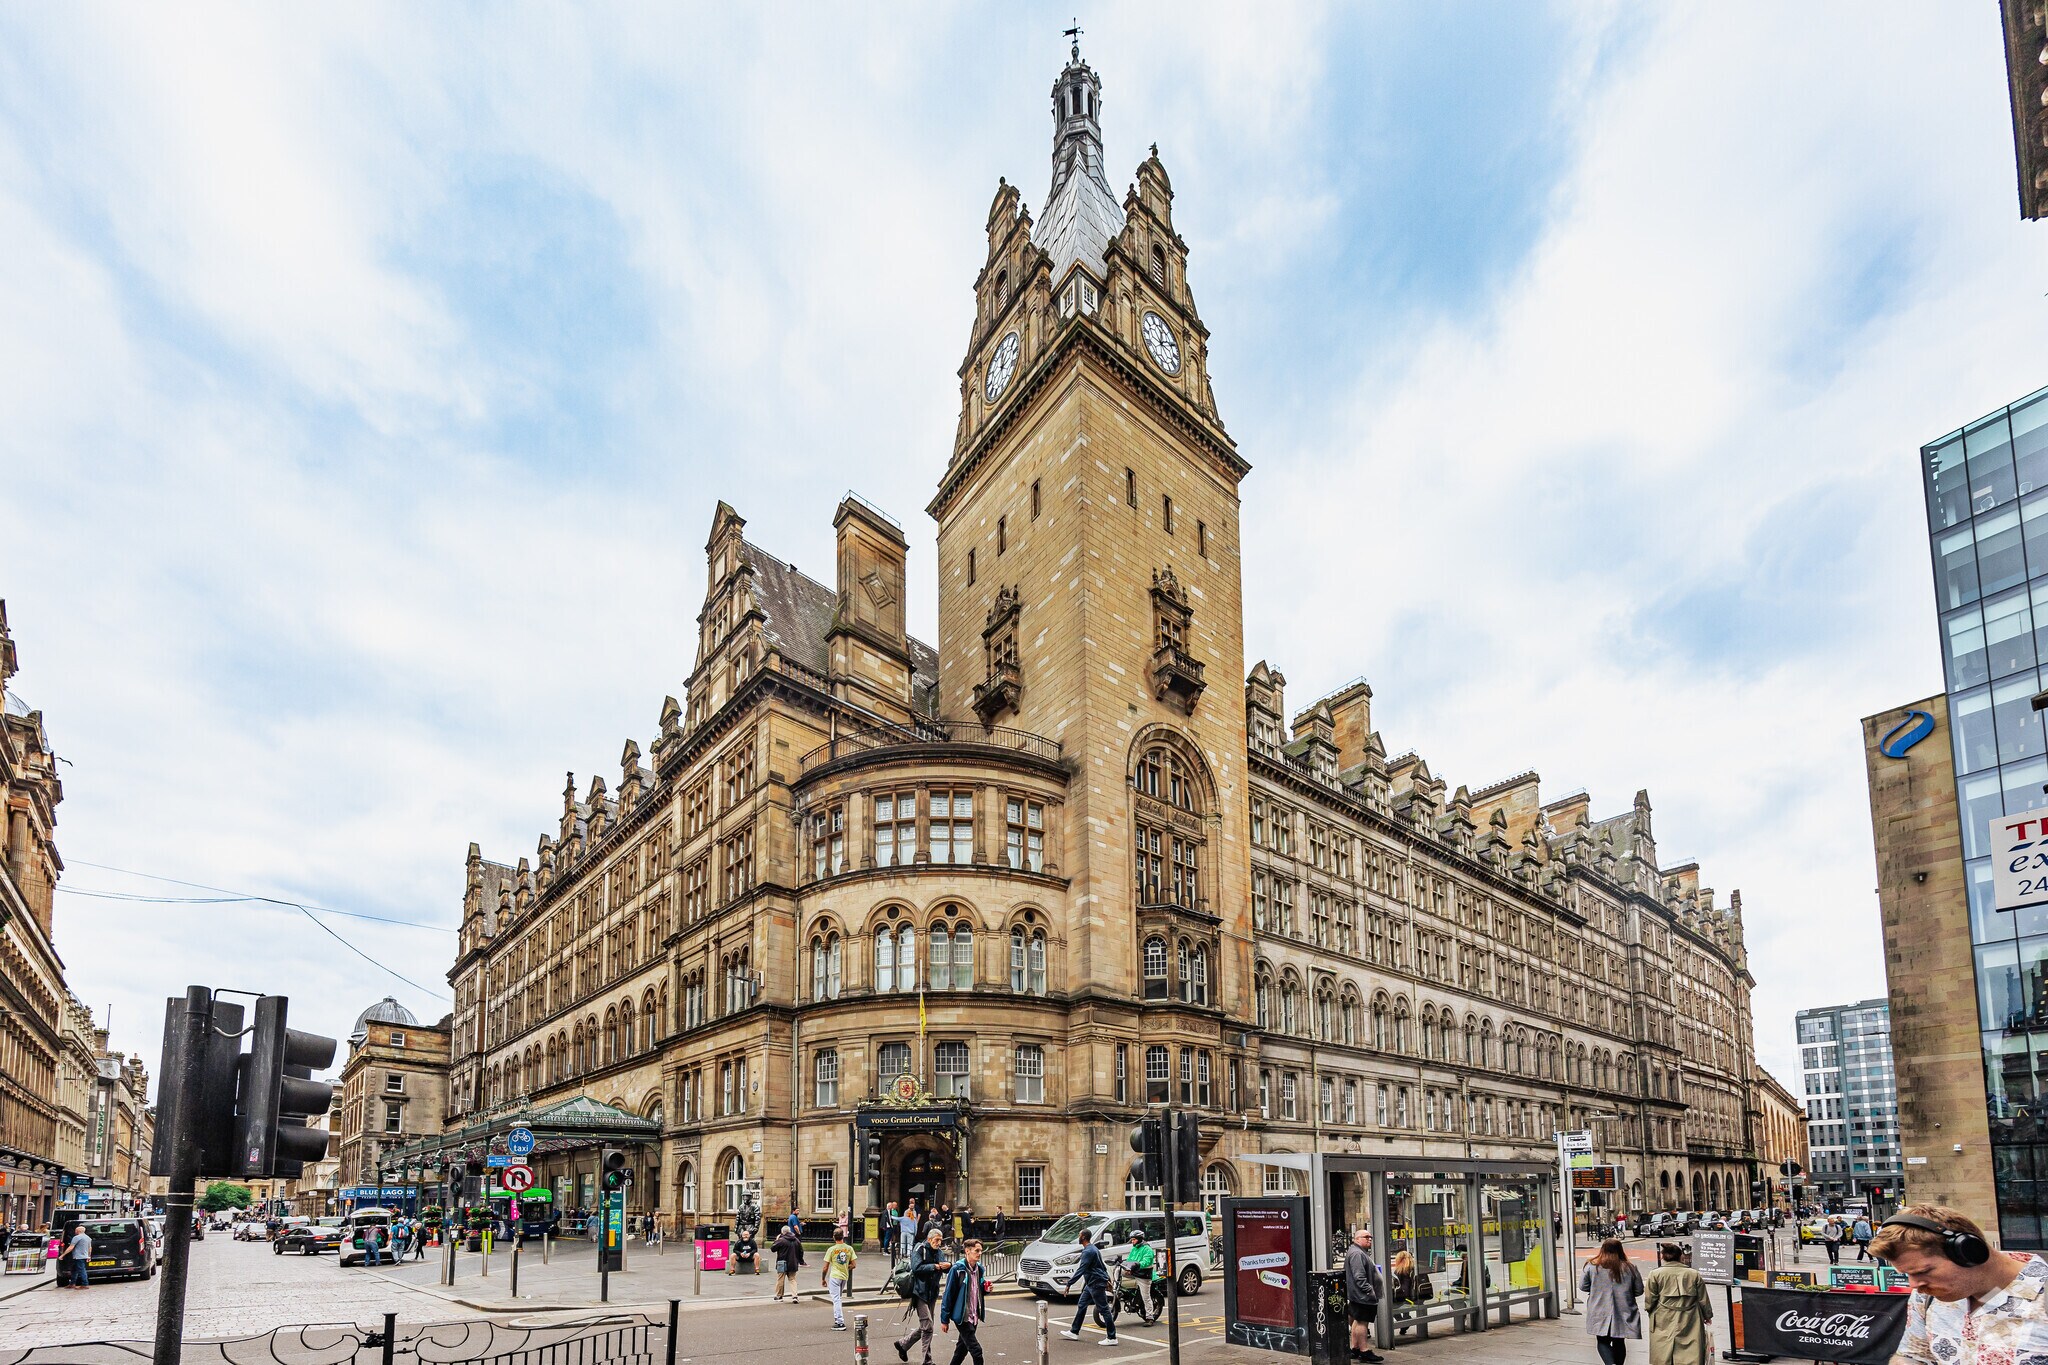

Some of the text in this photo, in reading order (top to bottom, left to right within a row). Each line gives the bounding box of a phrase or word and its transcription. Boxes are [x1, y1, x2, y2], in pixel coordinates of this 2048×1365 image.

[914, 1115, 940, 1123] Central
[513, 1144, 529, 1152] taxi
[1241, 1259, 1259, 1267] Thanks
[1262, 1273, 1281, 1284] Always
[1775, 1309, 1875, 1339] Coca-Cola
[1798, 1335, 1853, 1347] ZERO SUGAR
